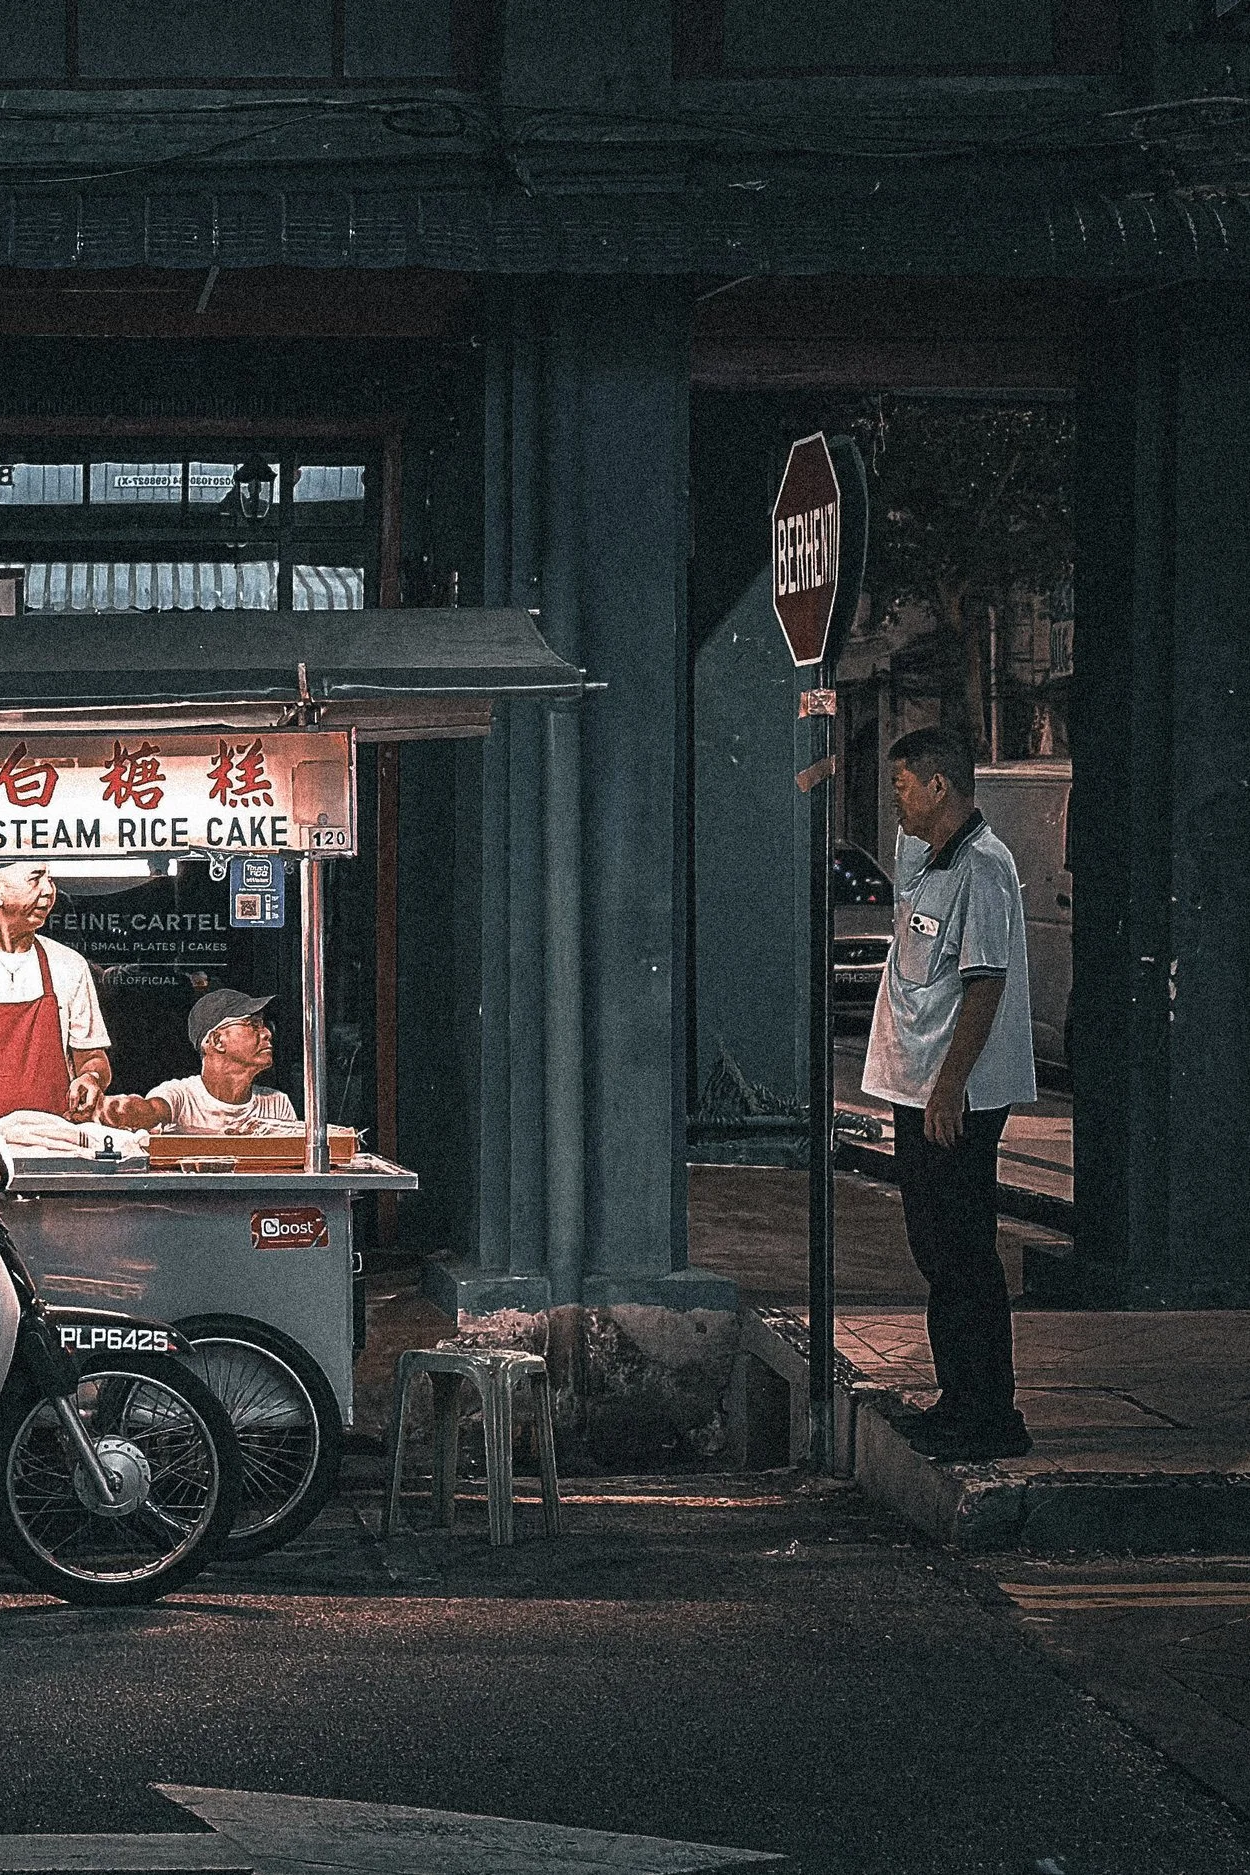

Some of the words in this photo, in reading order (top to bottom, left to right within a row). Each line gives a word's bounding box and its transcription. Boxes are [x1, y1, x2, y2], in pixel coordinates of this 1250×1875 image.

[778, 501, 836, 596] BERHENTI
[119, 817, 189, 848] RICE
[206, 815, 288, 847] CAKE
[312, 831, 346, 847] 120
[131, 913, 227, 931] CARTEL
[91, 942, 130, 951] SMALL
[133, 942, 177, 951] PLATES
[187, 942, 228, 951] CAKES
[60, 1327, 168, 1351] PLP6425
